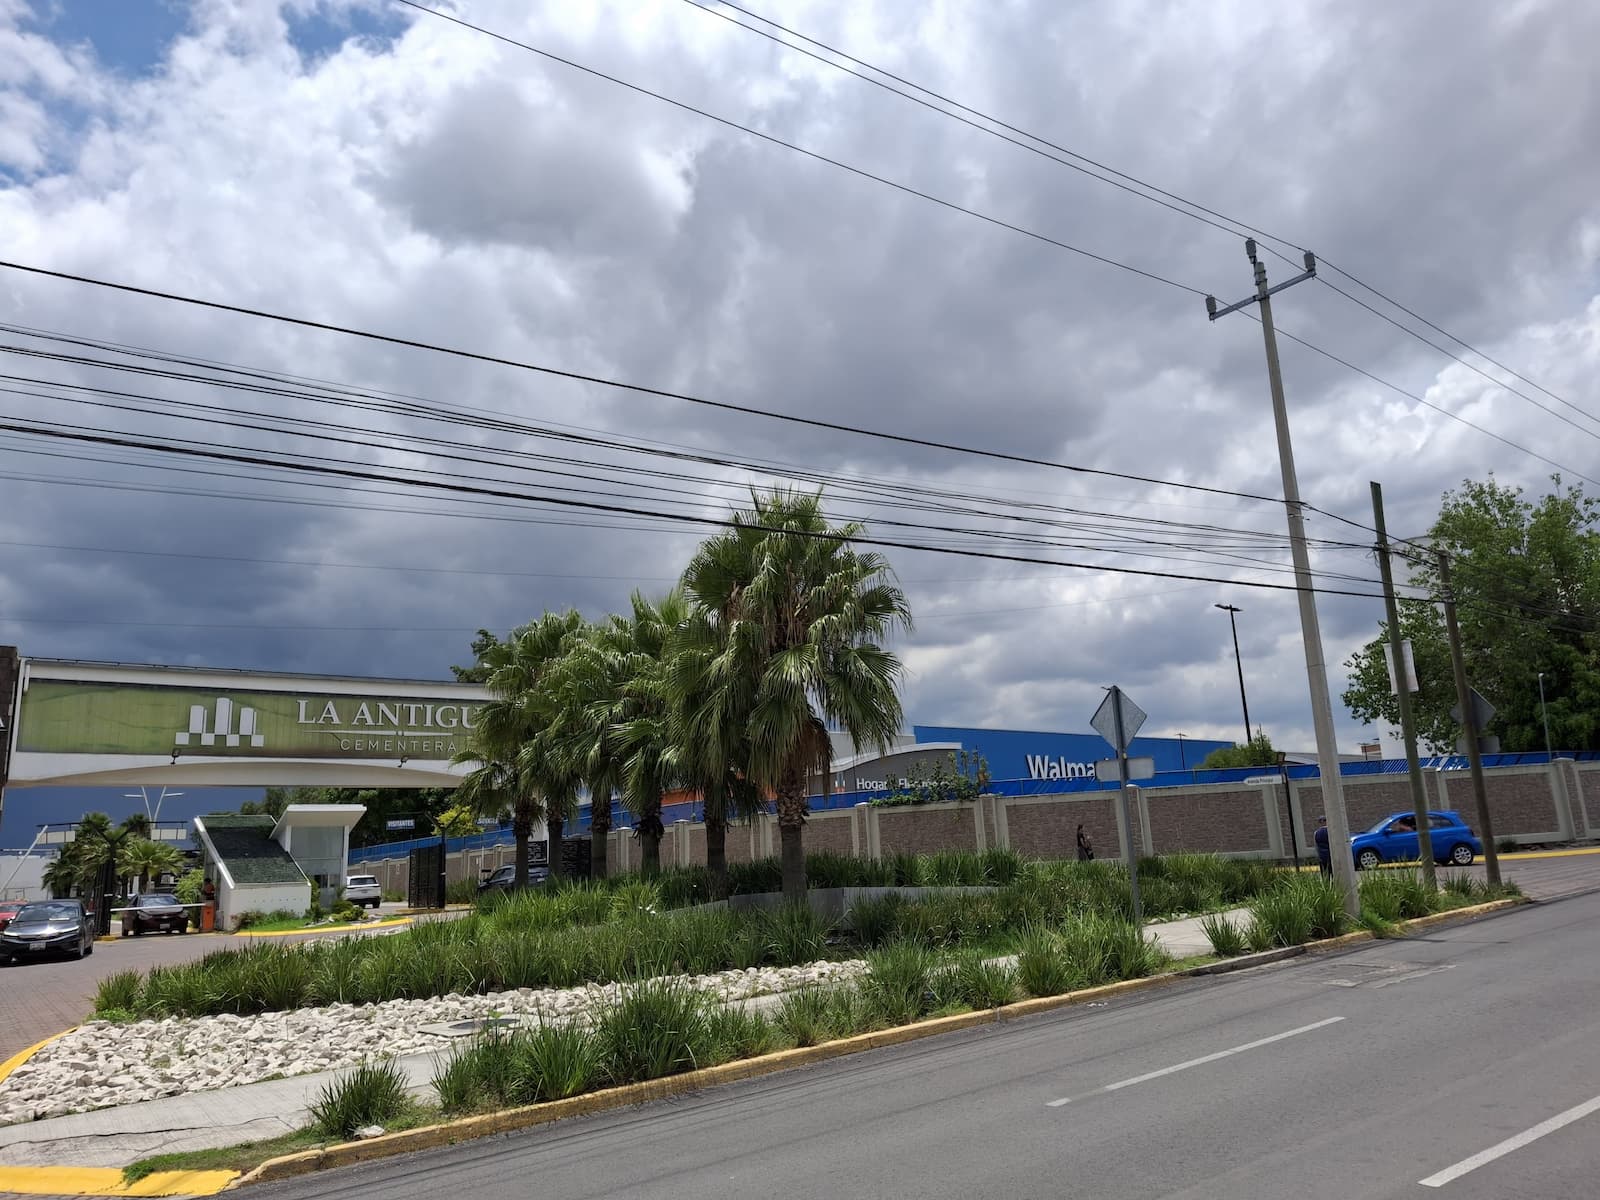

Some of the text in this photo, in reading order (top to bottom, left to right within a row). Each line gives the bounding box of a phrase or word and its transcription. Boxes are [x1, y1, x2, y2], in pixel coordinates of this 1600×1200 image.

[297, 700, 482, 729] LA ANTIGU
[340, 738, 457, 752] CEMENTERA
[1026, 754, 1096, 781] Walma
